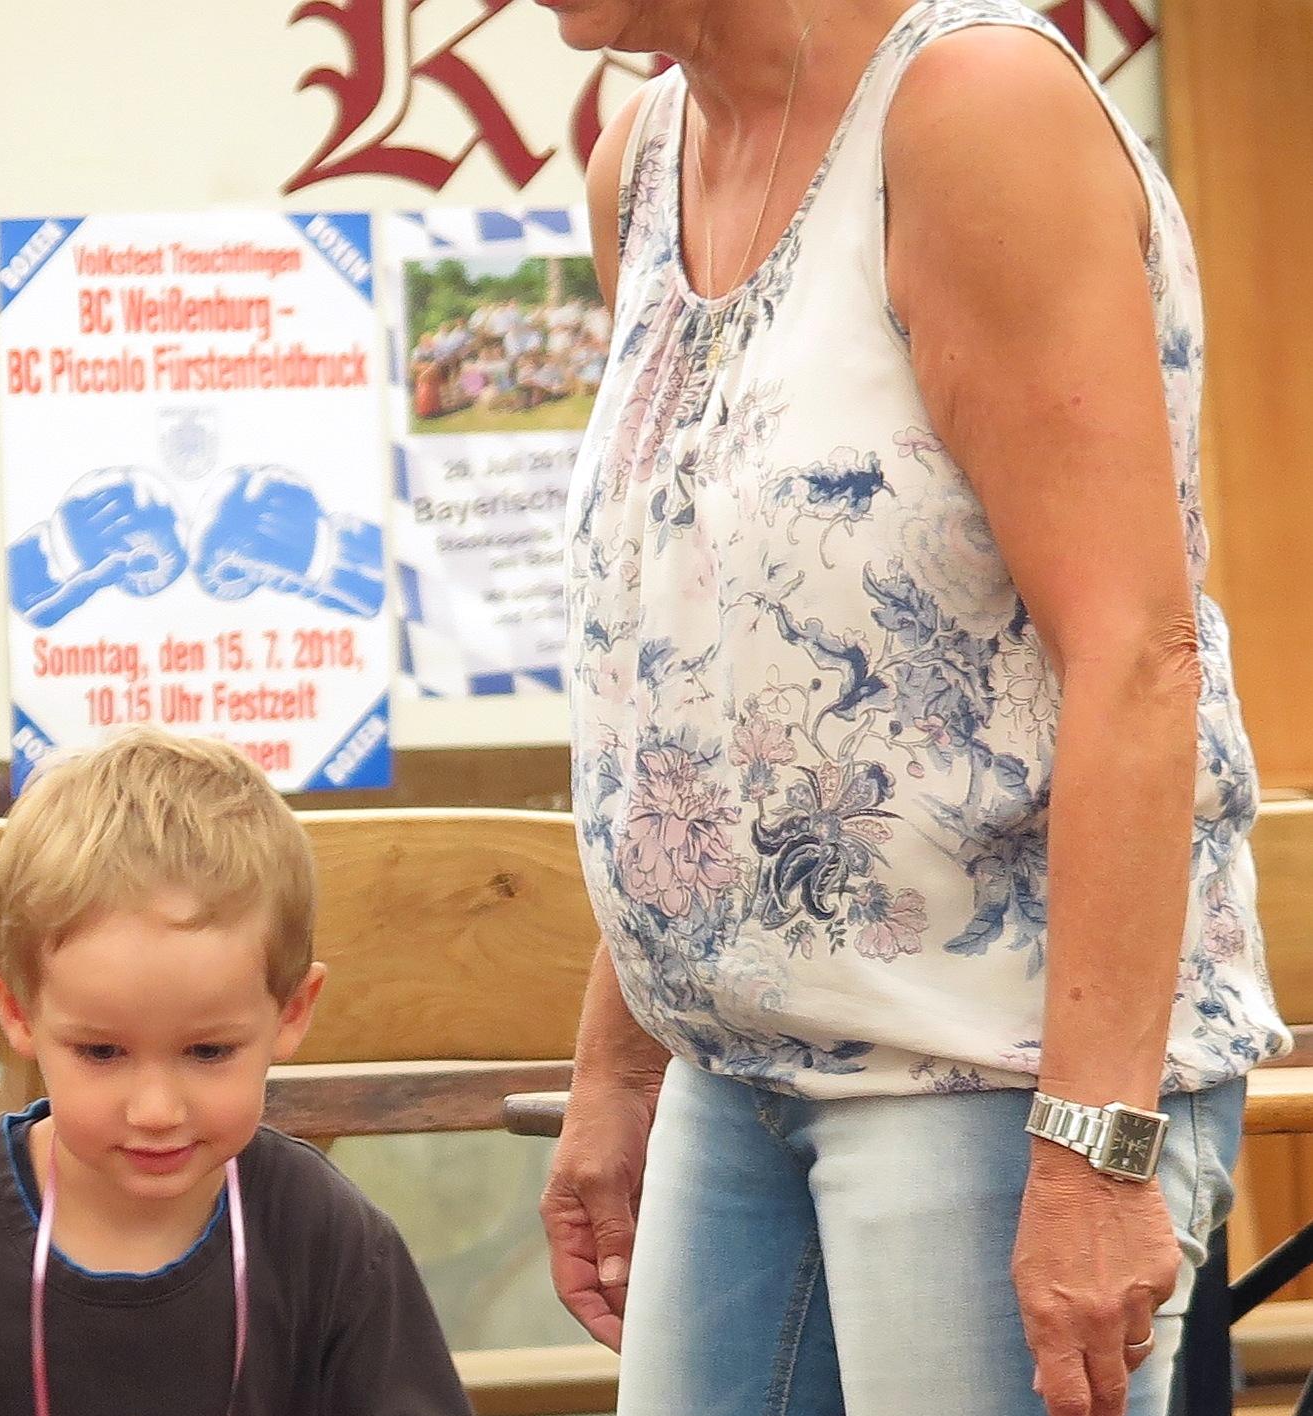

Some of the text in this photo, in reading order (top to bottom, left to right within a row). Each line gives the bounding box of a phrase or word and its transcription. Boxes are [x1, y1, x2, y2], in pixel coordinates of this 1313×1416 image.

[75, 242, 302, 278] Volksfest Treuchtlingen
[79, 287, 112, 334] BC
[122, 287, 271, 340] Weißenburg
[7, 342, 367, 394] BC Piccolo Fürstenfeldbruck
[33, 627, 366, 683] Sonntag, den 15. 7. 2018,
[85, 678, 316, 726] 10.15 Uhr Festzeit
